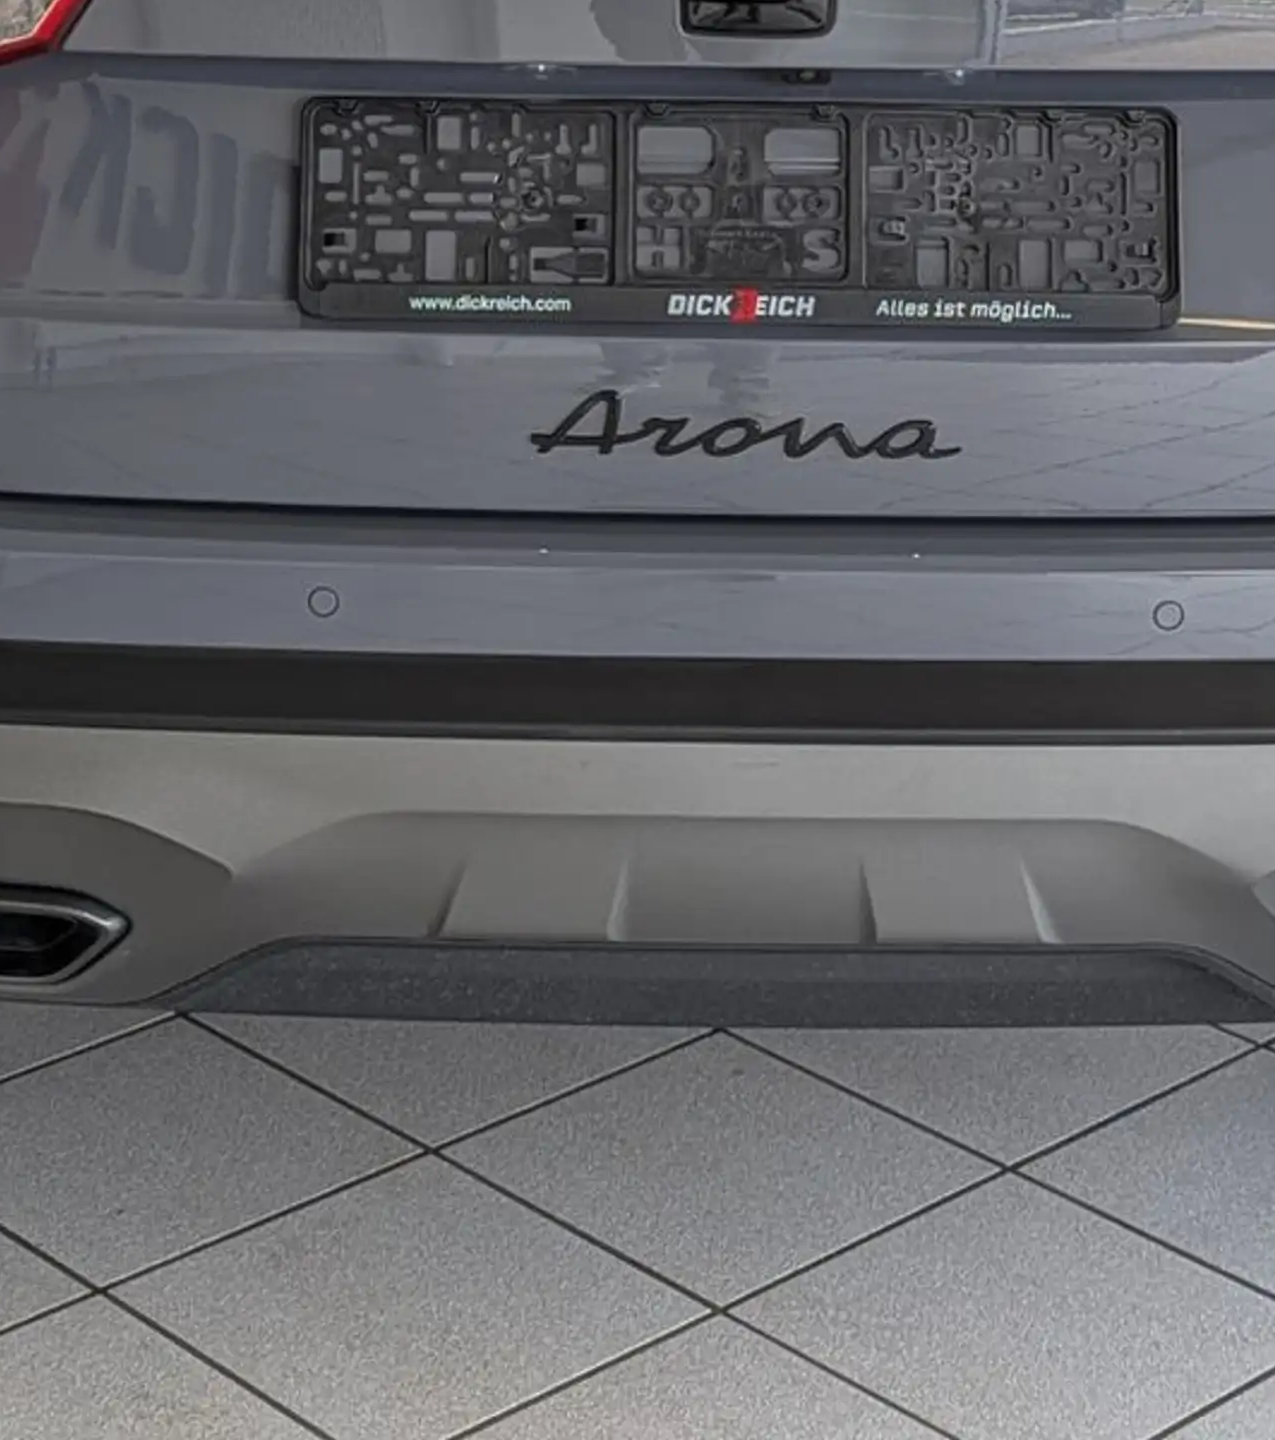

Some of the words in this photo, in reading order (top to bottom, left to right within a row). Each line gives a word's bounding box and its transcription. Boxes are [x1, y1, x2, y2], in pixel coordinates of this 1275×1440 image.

[408, 295, 572, 313] www.dickreich.com
[667, 289, 816, 322] DICKEICH
[875, 299, 929, 318] Alles
[933, 298, 967, 319] ist
[970, 300, 1073, 323] möglich...
[529, 389, 962, 458] Arona
